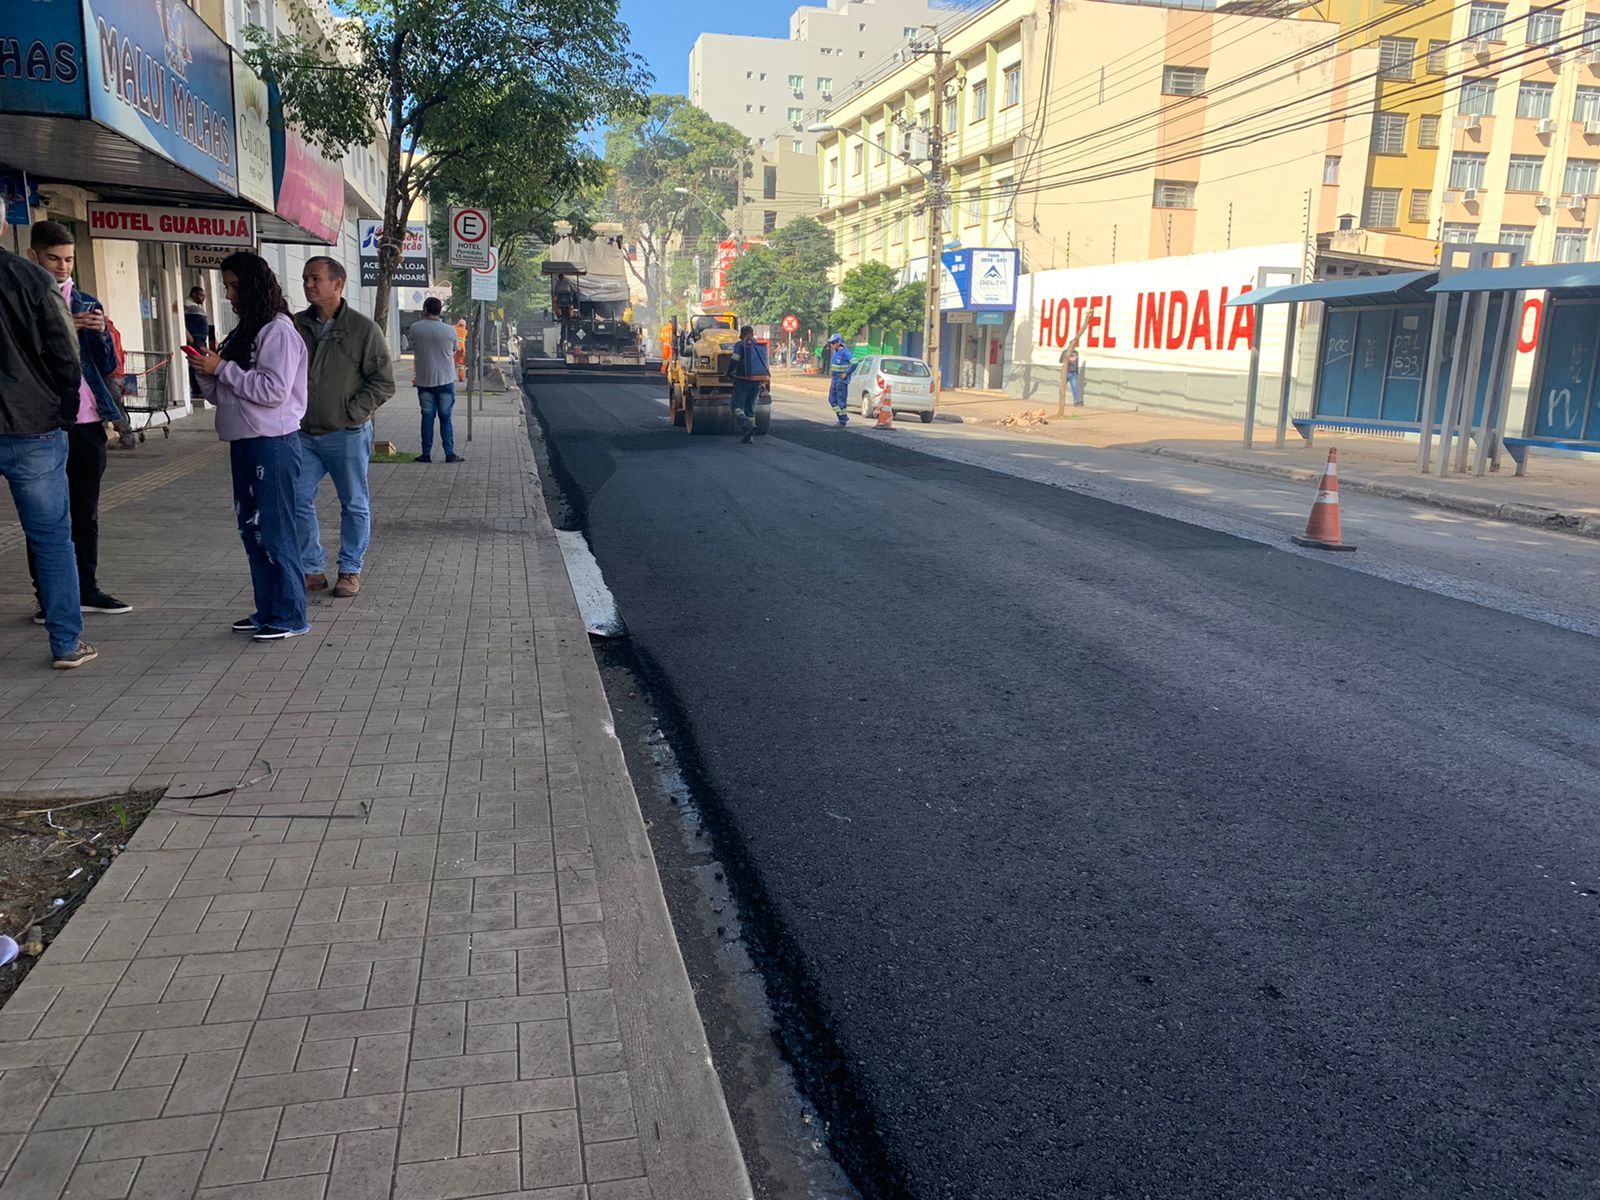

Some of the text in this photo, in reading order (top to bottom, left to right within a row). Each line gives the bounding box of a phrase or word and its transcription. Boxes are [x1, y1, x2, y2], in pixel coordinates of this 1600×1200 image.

[171, 76, 231, 168] MALHAS
[91, 210, 250, 238] HOTEL GUARUJÁ
[463, 216, 477, 235] E
[458, 242, 481, 250] HOTEL
[363, 272, 376, 280] AV.
[1039, 276, 1255, 350] HOTEL INDAIÁ
